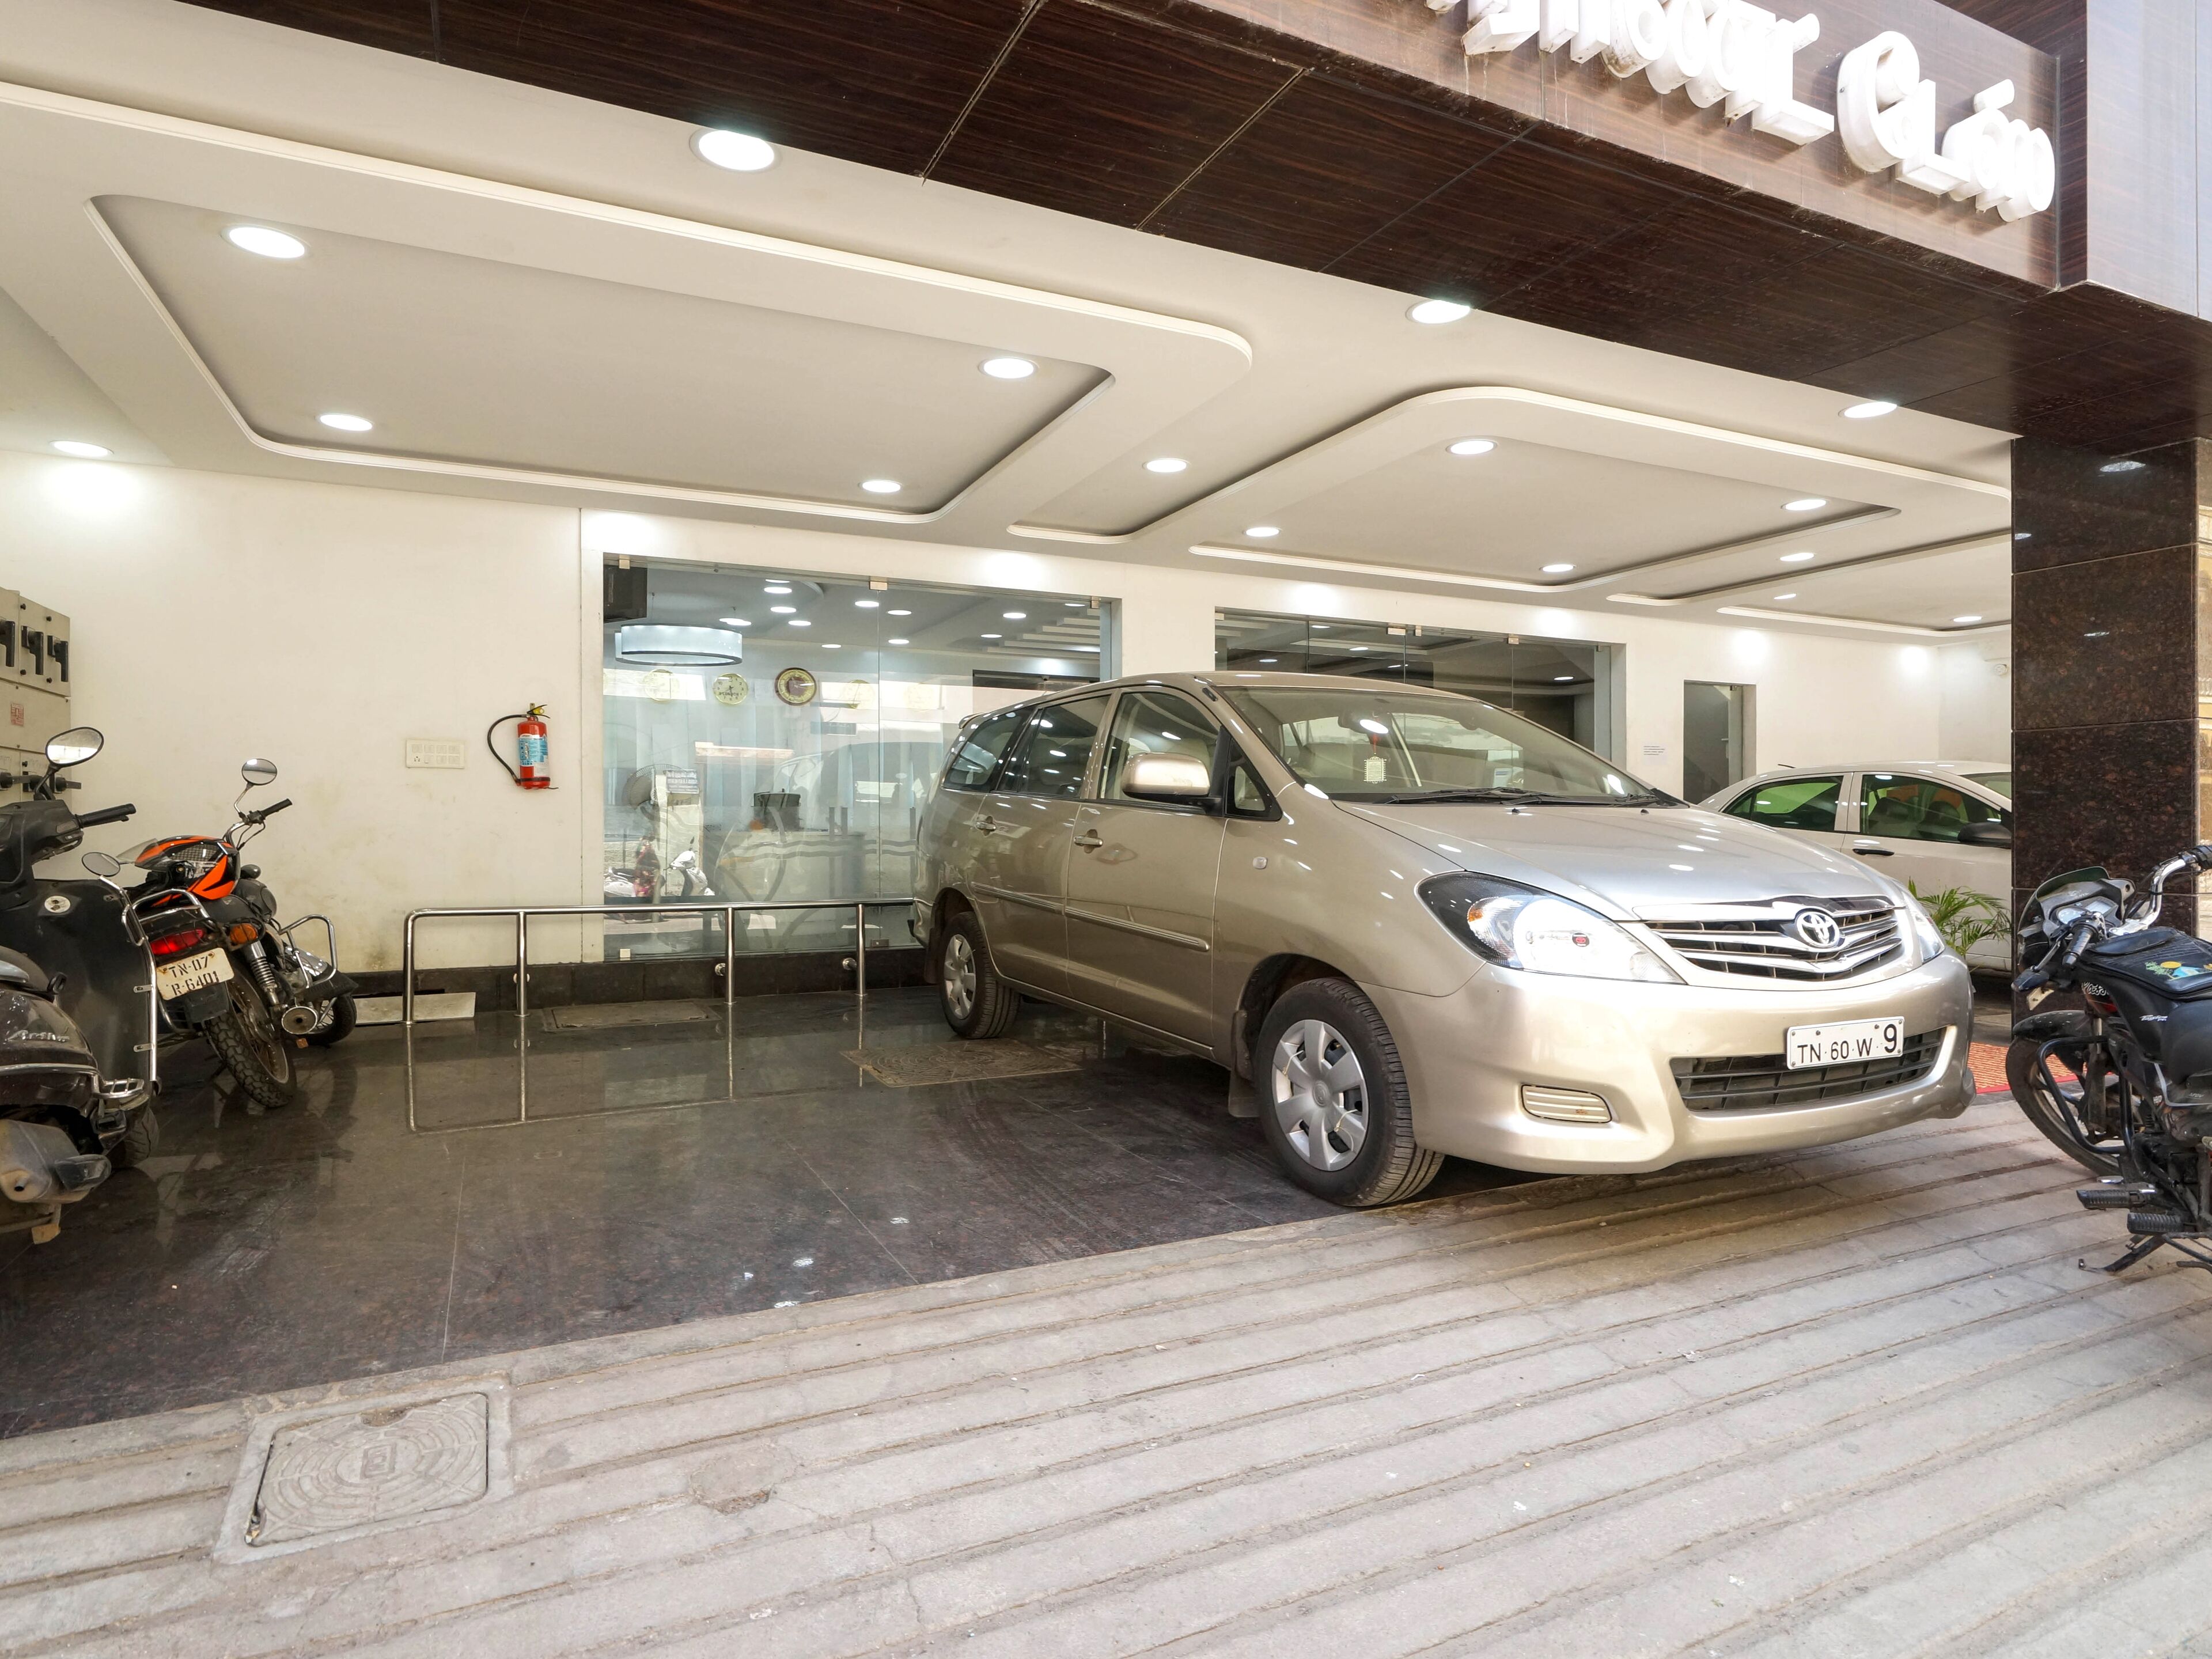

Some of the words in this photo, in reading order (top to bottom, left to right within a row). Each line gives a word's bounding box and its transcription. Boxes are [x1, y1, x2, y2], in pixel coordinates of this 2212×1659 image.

[1797, 1043, 1821, 1063] TN
[1831, 1040, 1849, 1060] 60
[1857, 1037, 1873, 1057] W
[1884, 1024, 1897, 1054] 9
